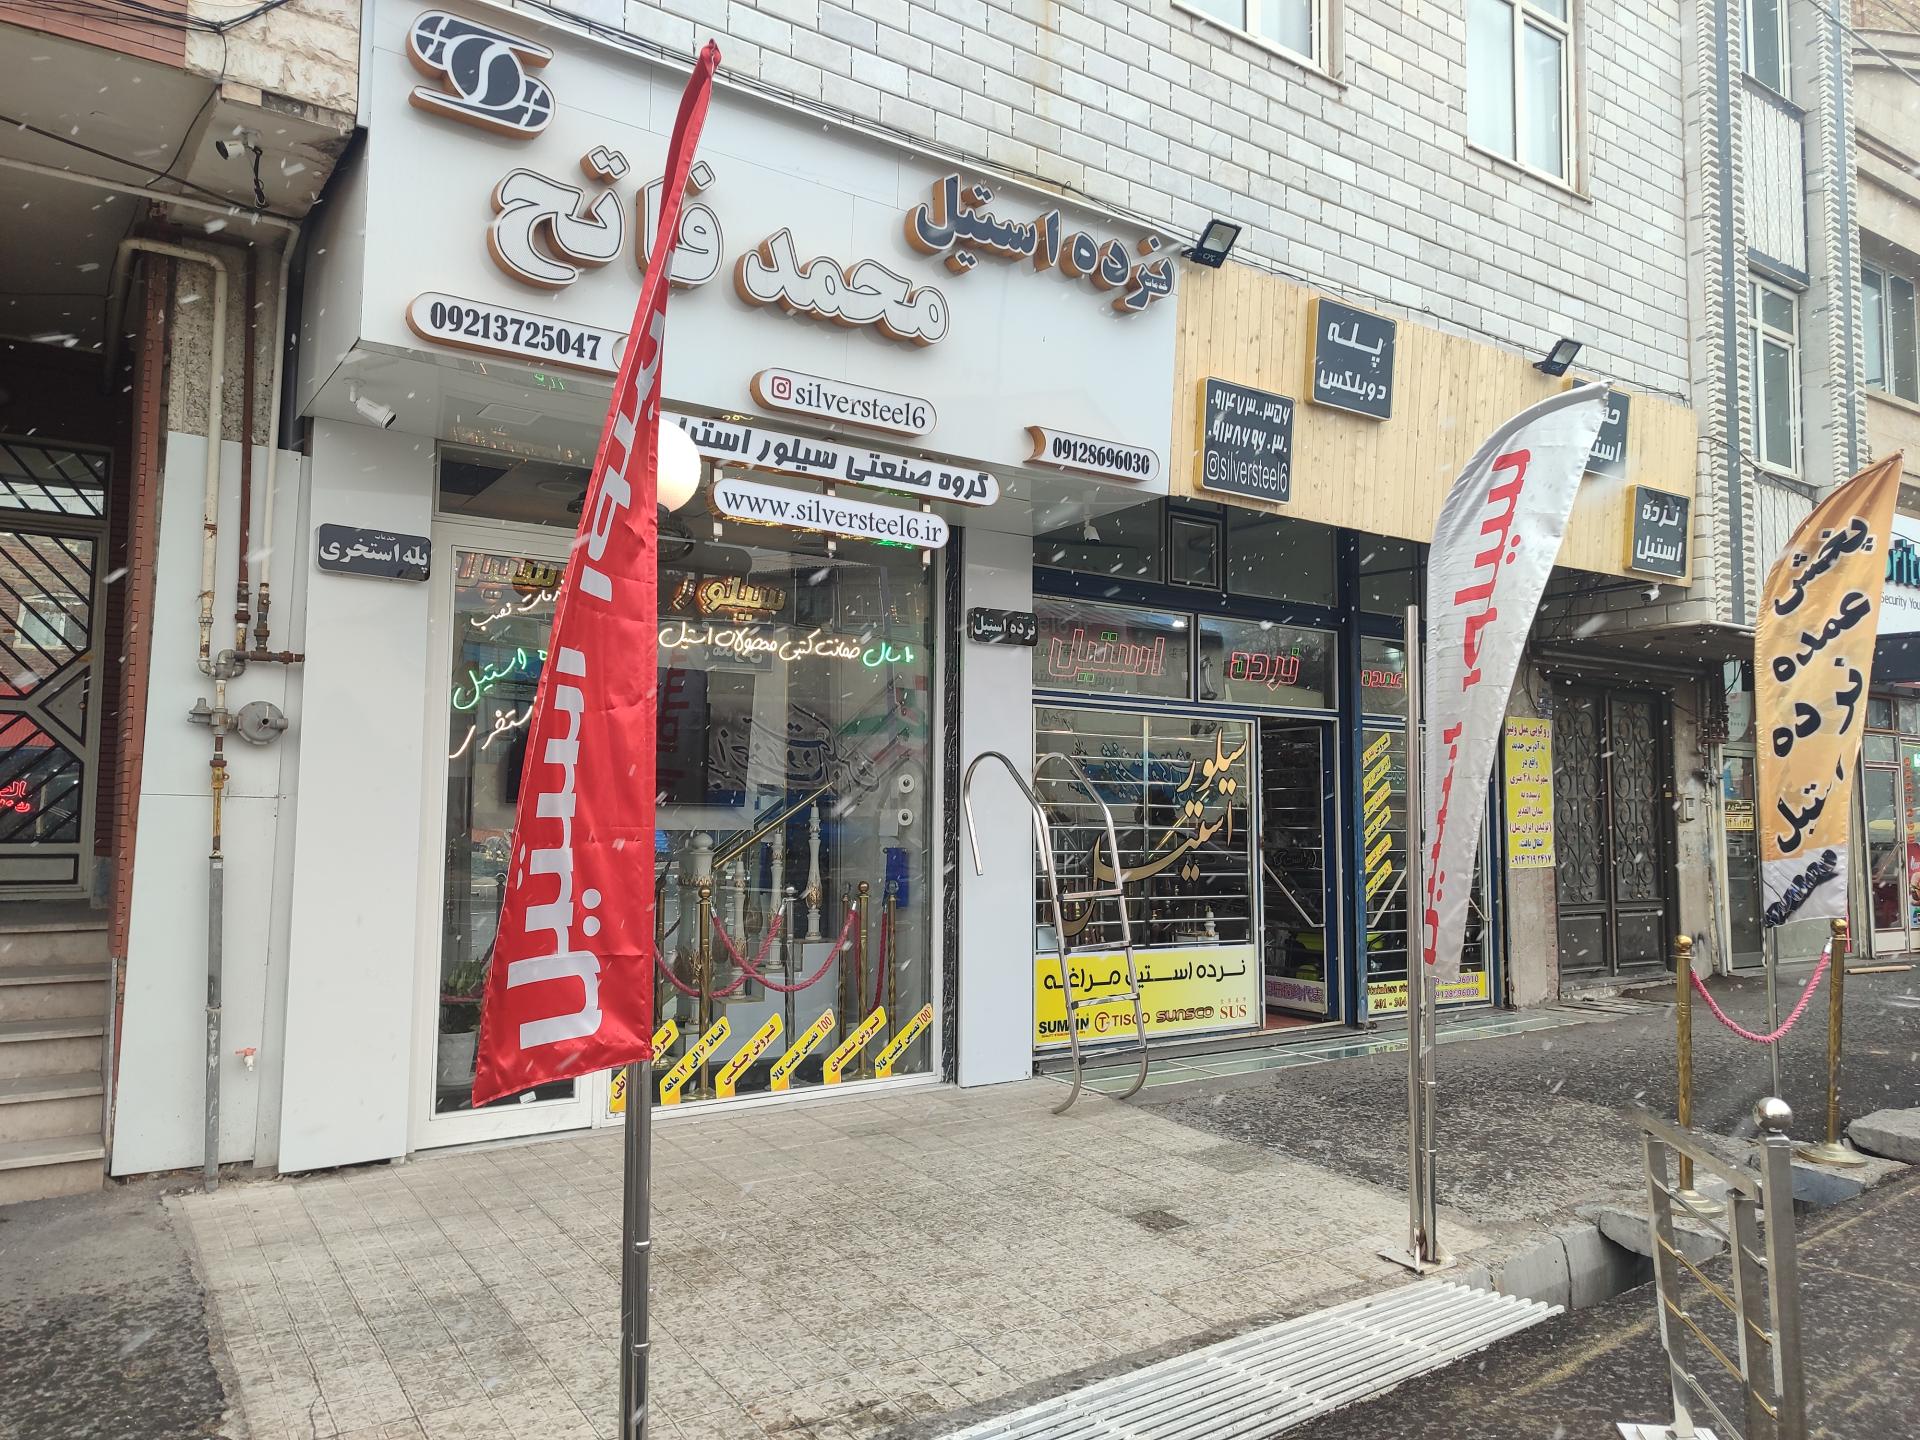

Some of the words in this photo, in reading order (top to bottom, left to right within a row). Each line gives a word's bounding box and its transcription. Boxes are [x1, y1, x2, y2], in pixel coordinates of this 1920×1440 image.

[488, 145, 724, 289] فاتح
[908, 173, 1061, 273] استیل
[736, 227, 949, 344] محمد
[1062, 234, 1175, 311] نرده
[430, 302, 601, 361] 09213725047
[1327, 322, 1384, 367] پله
[1320, 368, 1387, 401] دوبلکس
[796, 383, 926, 429] silversteel6
[679, 416, 752, 454] استی
[757, 438, 838, 472] سیلور
[846, 453, 931, 487] صنعتی
[1052, 437, 1150, 475] 09128696030
[1220, 450, 1288, 493] silversteel6
[938, 473, 989, 500] گروه
[722, 488, 943, 542] www.silversteel6.ir
[1641, 500, 1680, 527] نرده
[319, 538, 400, 563] استخری
[402, 545, 428, 574] پله
[1635, 536, 1683, 563] استیل
[1774, 518, 1874, 616] پخش
[672, 575, 787, 621] سیلور
[658, 622, 713, 650] استیل
[975, 614, 1007, 636] استیل
[1010, 619, 1036, 641] نرده
[1772, 591, 1871, 682] عمده
[779, 628, 821, 661] کتبی
[815, 638, 861, 660] ضمانت
[862, 641, 901, 668] سال
[1048, 629, 1166, 683] استیل
[452, 647, 527, 710] استیل
[1230, 647, 1300, 691] نرده
[1772, 656, 1863, 758] نرده
[1176, 727, 1247, 796] سیلور
[507, 646, 601, 1051] استیل
[1058, 799, 1234, 938] استیل
[1043, 967, 1121, 993] مراغه
[1196, 960, 1246, 983] نرده
[1039, 1017, 1090, 1034] SUMIN
[1219, 1004, 1247, 1020] SUS
[705, 1023, 728, 1049] اقساط
[752, 1021, 777, 1056] فروش
[854, 1014, 880, 1046] فروش
[722, 1051, 751, 1087] چکی
[829, 1039, 855, 1073] نقدی
